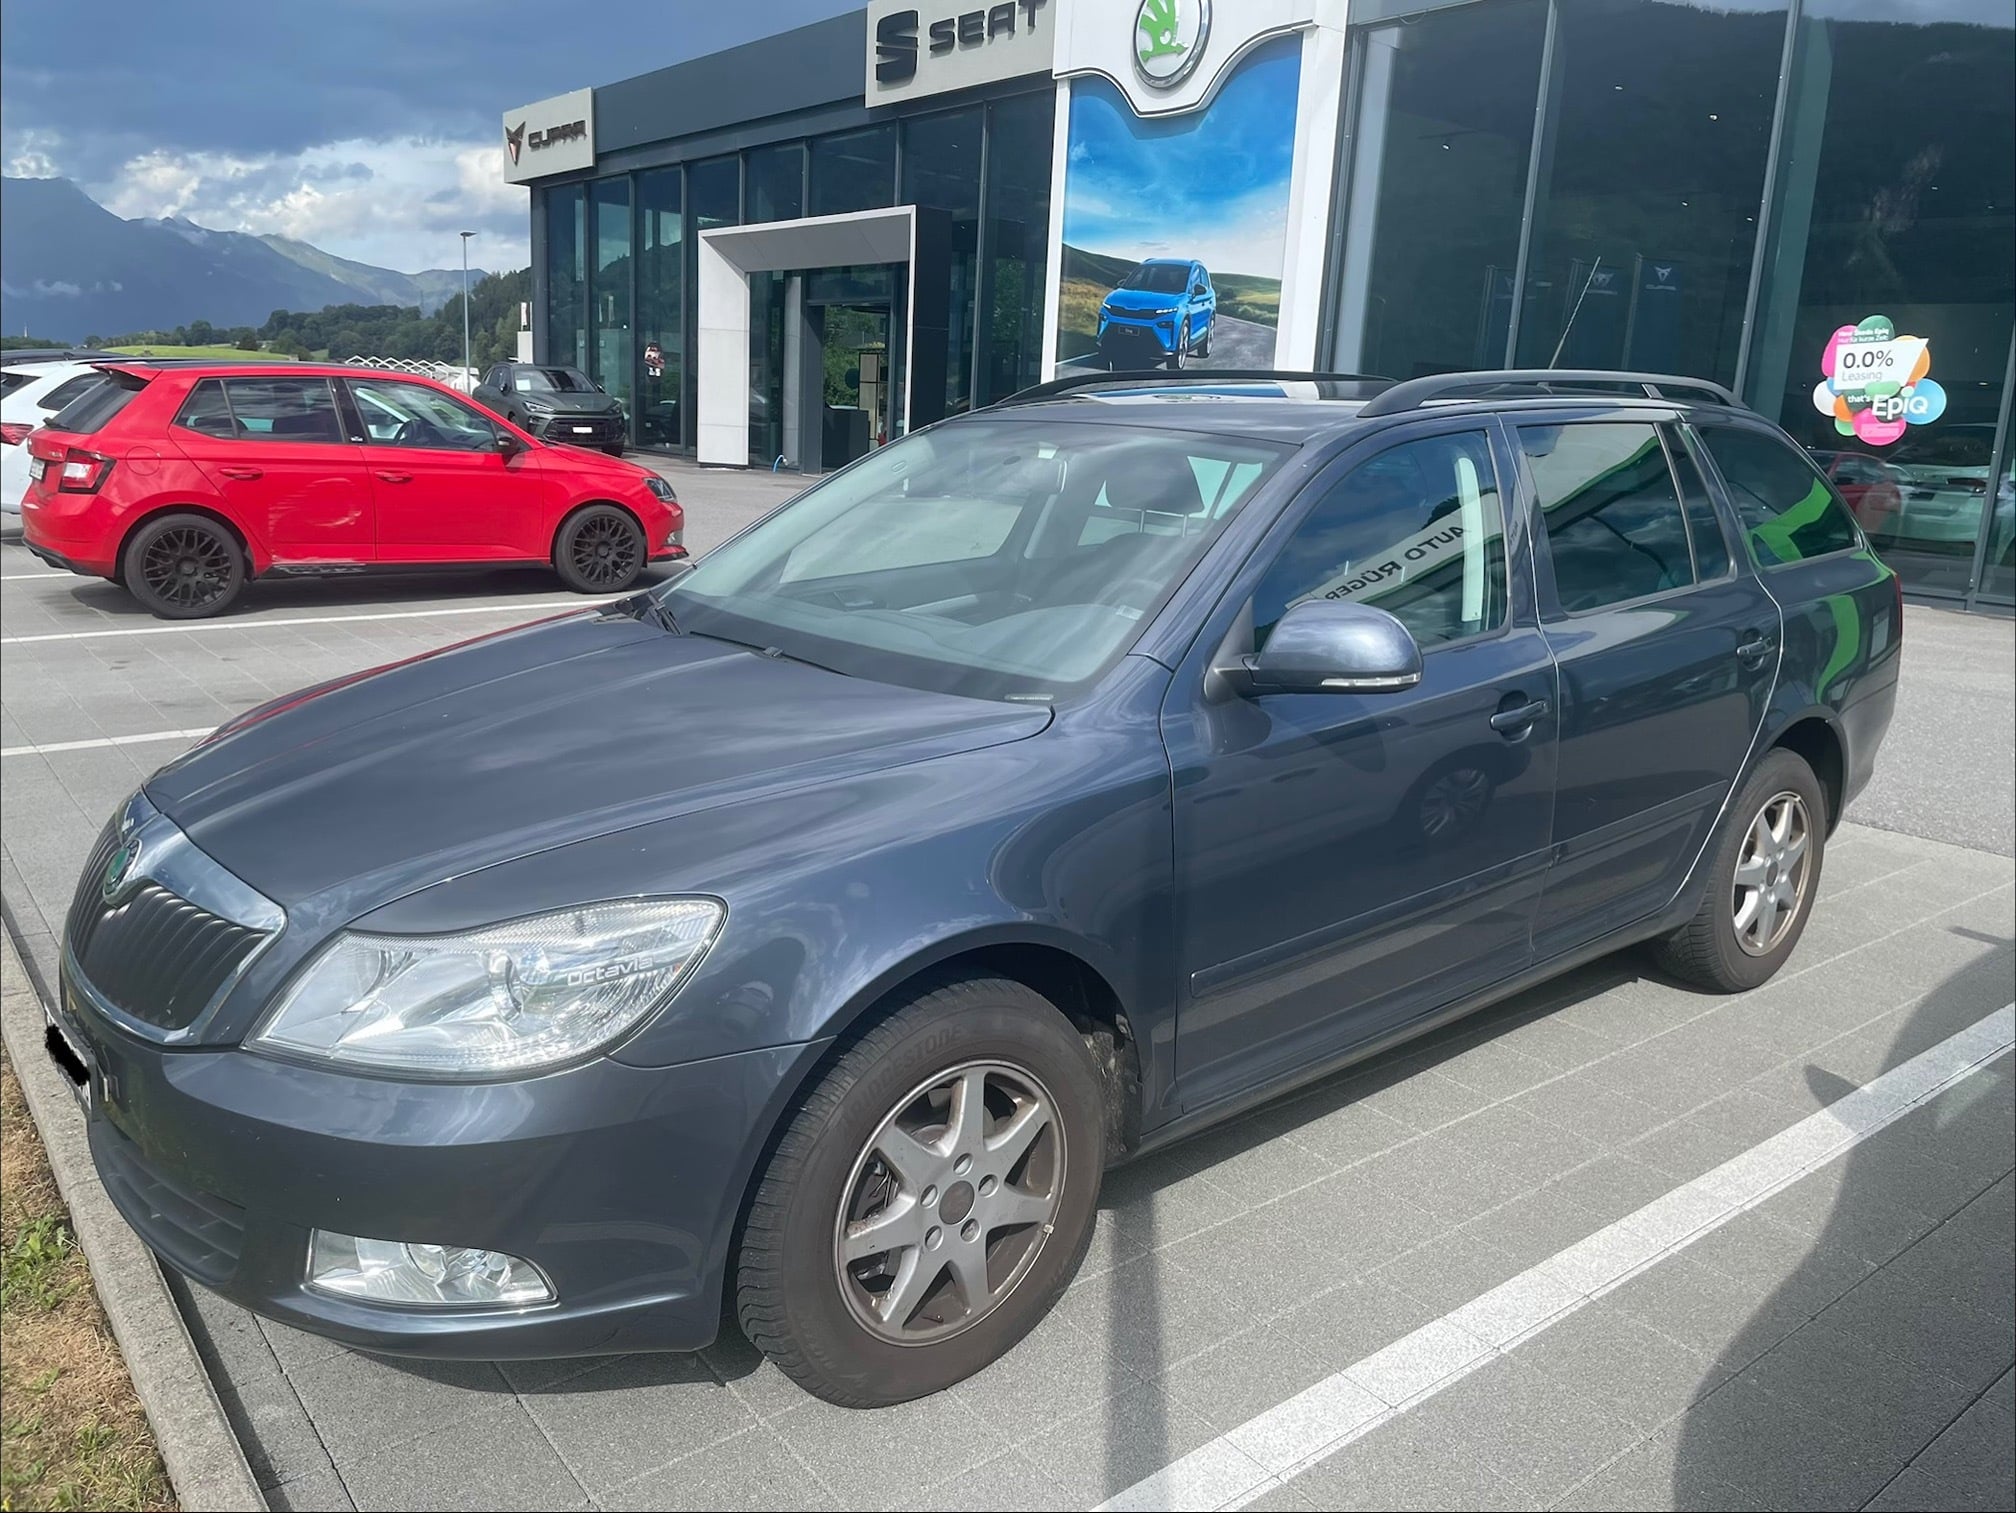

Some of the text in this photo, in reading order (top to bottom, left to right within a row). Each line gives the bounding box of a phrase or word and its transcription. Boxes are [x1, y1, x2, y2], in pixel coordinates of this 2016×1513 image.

[929, 0, 1047, 56] SEAT
[528, 119, 587, 149] CUPRA
[1843, 349, 1894, 369] 0.0%
[1841, 370, 1883, 383] Leasing
